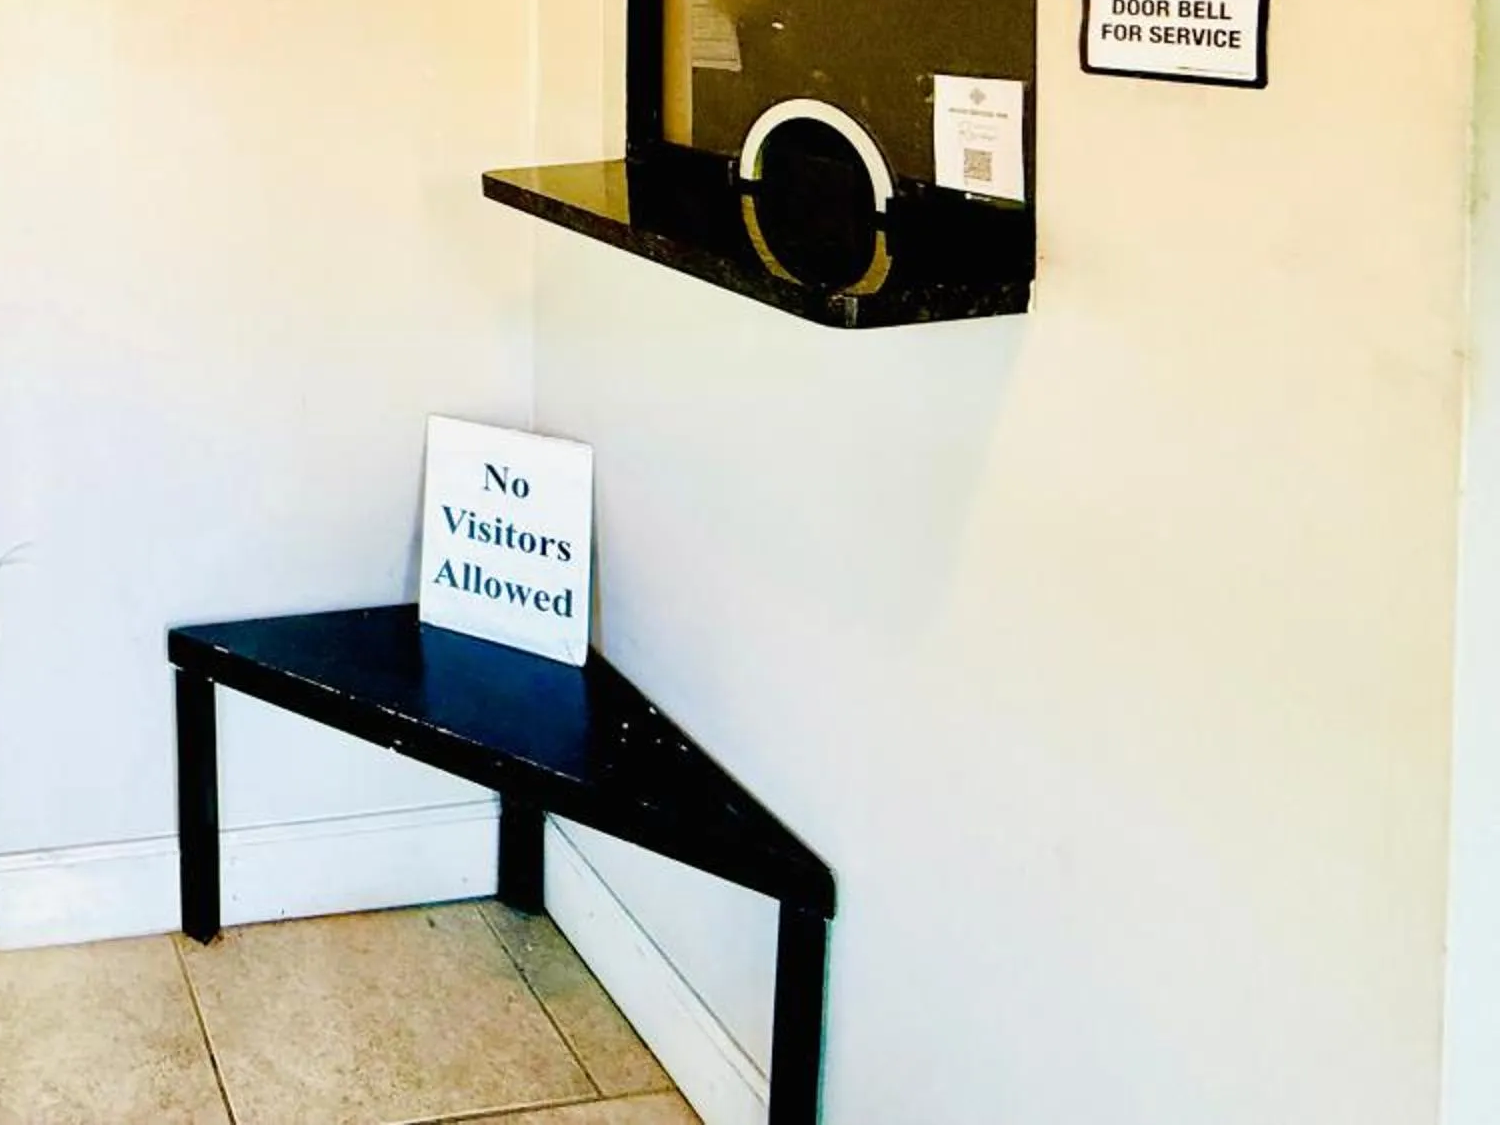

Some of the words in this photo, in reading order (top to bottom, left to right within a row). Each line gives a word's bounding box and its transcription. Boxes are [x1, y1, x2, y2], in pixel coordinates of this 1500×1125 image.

[1177, 0, 1233, 20] BELL
[1101, 23, 1142, 42] FOR
[1149, 26, 1242, 49] SERVICE
[483, 461, 530, 500] No
[441, 503, 573, 563] Visitors
[432, 558, 574, 619] Allowed
